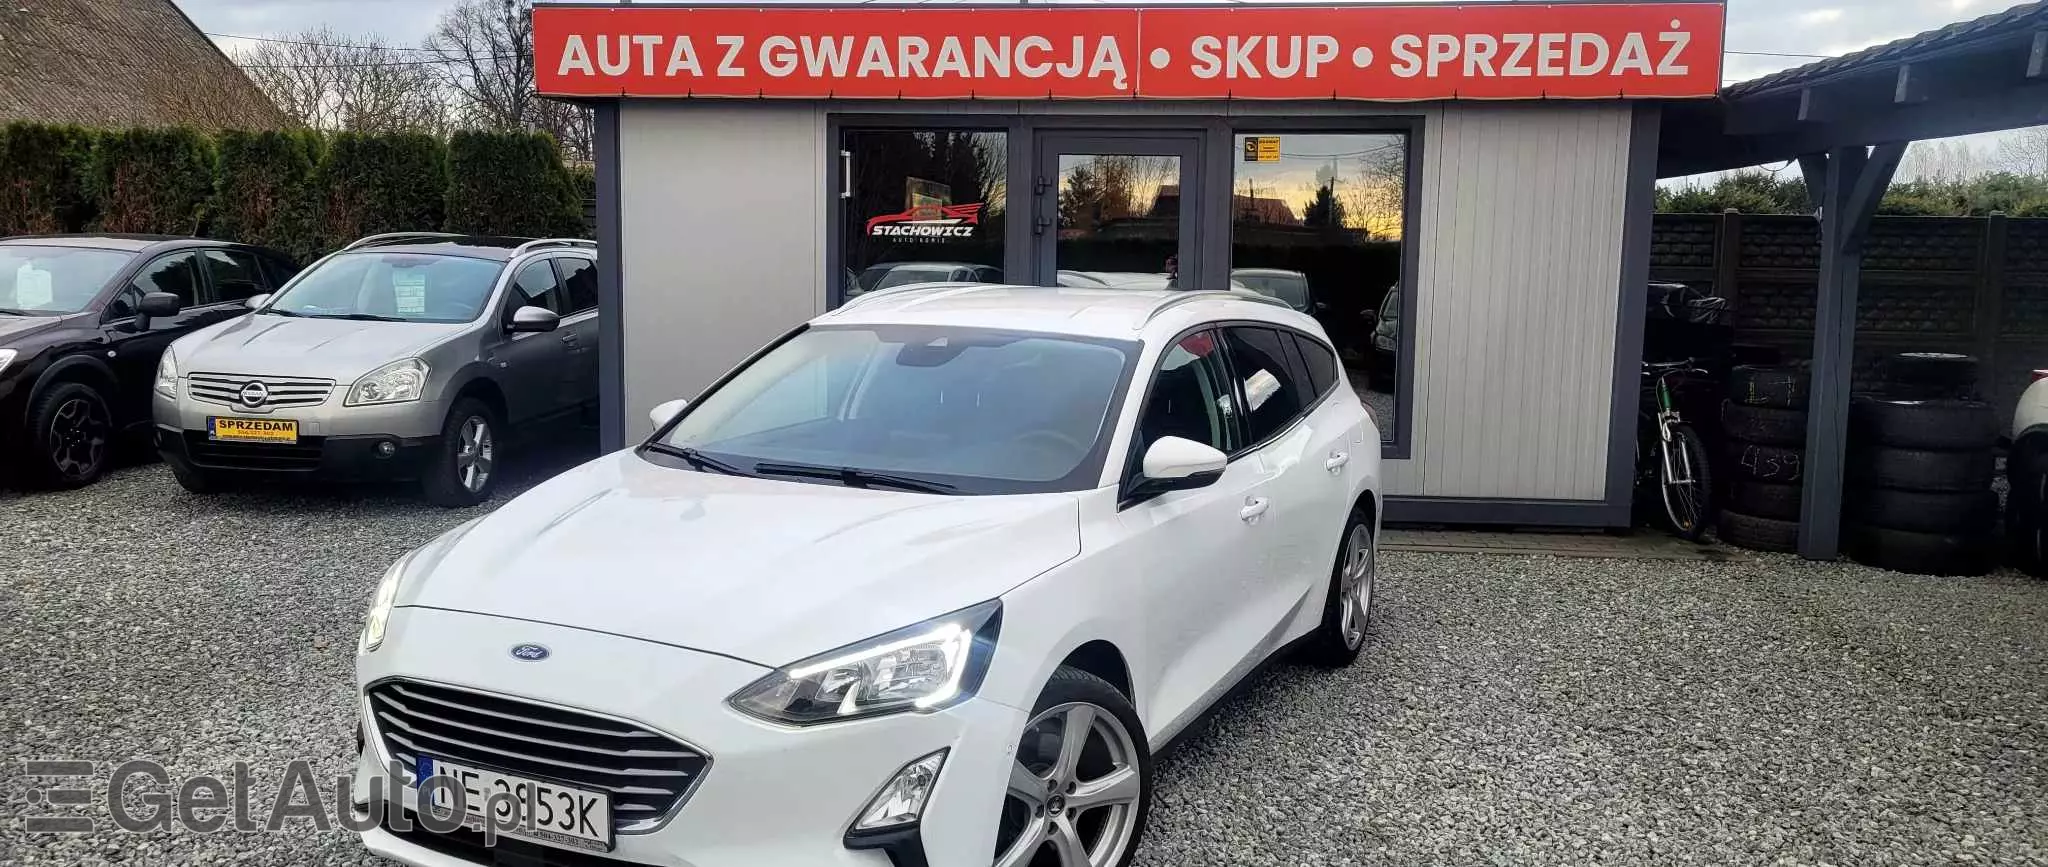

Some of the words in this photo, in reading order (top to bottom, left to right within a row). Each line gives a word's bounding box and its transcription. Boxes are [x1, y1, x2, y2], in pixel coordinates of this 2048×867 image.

[557, 34, 703, 78] AUTA
[716, 35, 745, 77] Z
[759, 35, 1128, 91] GWARANCJĄ
[1190, 35, 1340, 79] SKUP
[1389, 18, 1692, 78] SPRZEDAŻ
[871, 225, 975, 237] STACHOWICZ
[219, 419, 293, 432] SPRZEDAM
[439, 765, 481, 812] NE
